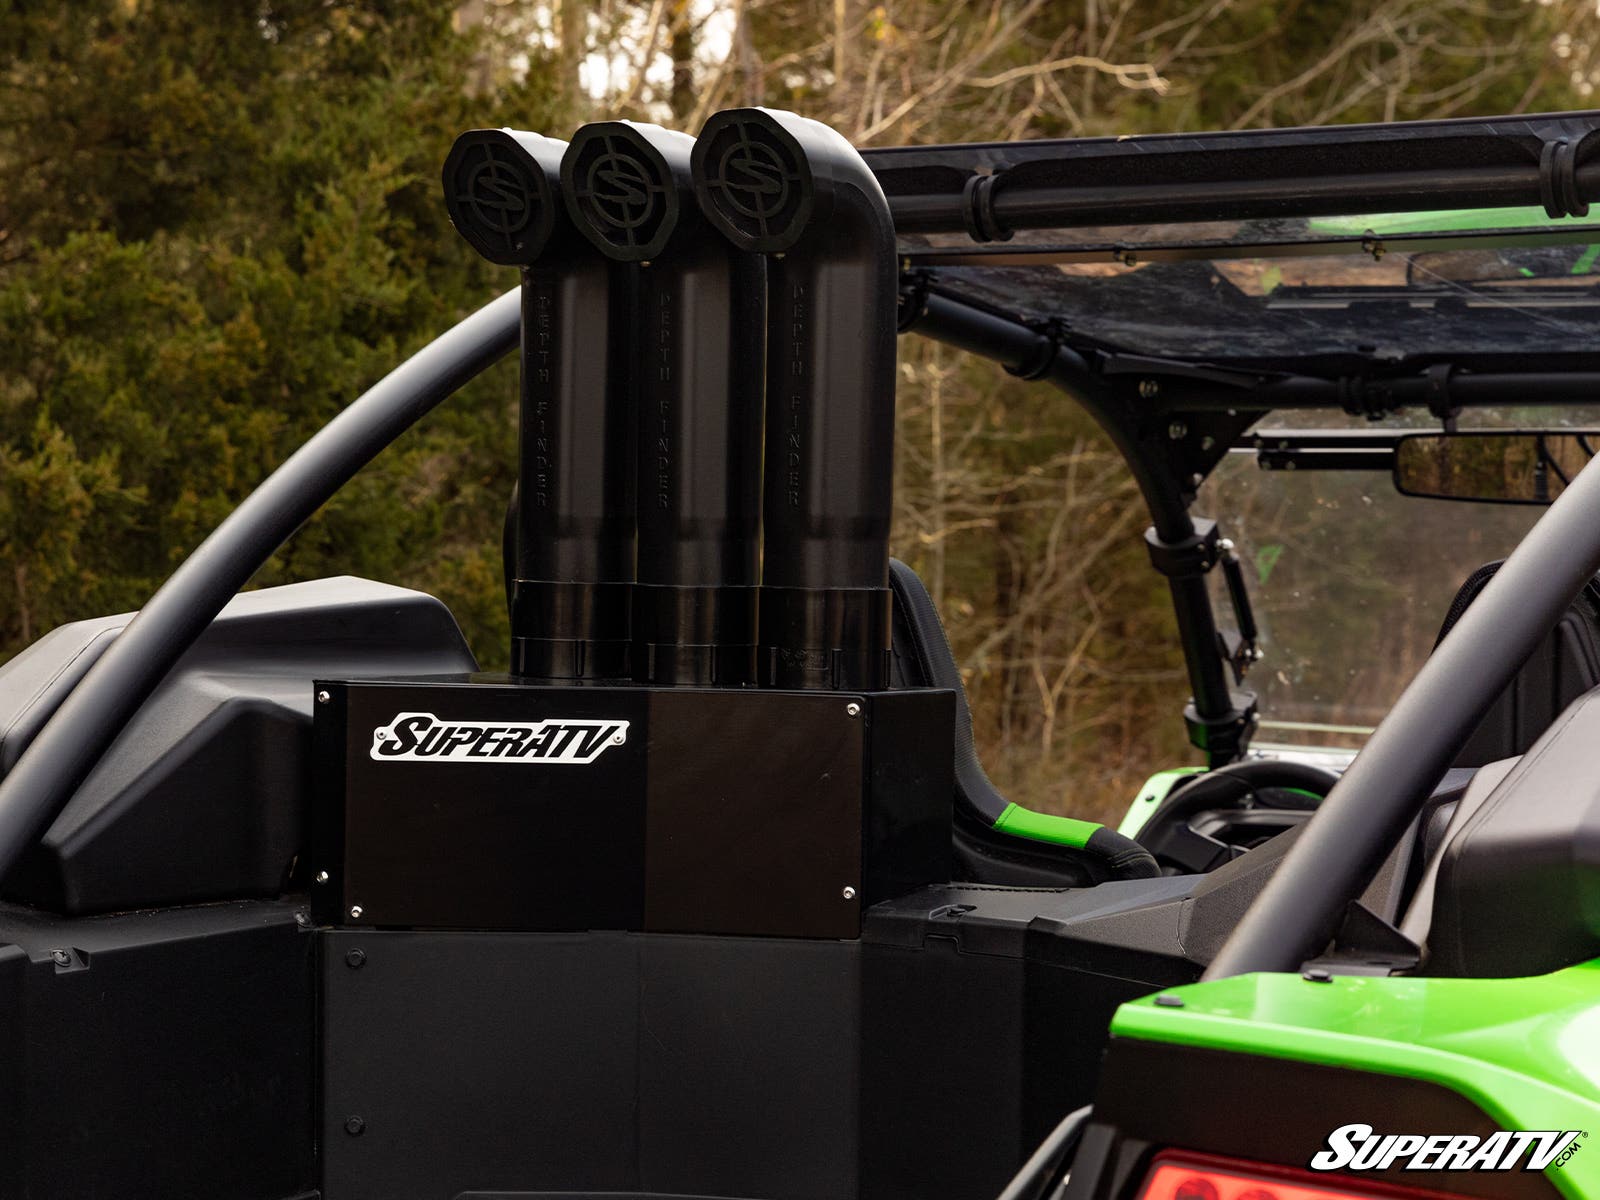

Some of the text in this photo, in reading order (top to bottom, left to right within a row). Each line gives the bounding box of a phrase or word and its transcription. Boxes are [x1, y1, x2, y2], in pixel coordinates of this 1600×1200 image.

[535, 294, 552, 508] DEPTH FINDER
[656, 294, 672, 508] DEPTH FINDER
[788, 285, 808, 506] DEPTH FINDER
[379, 716, 620, 758] SUPERATV
